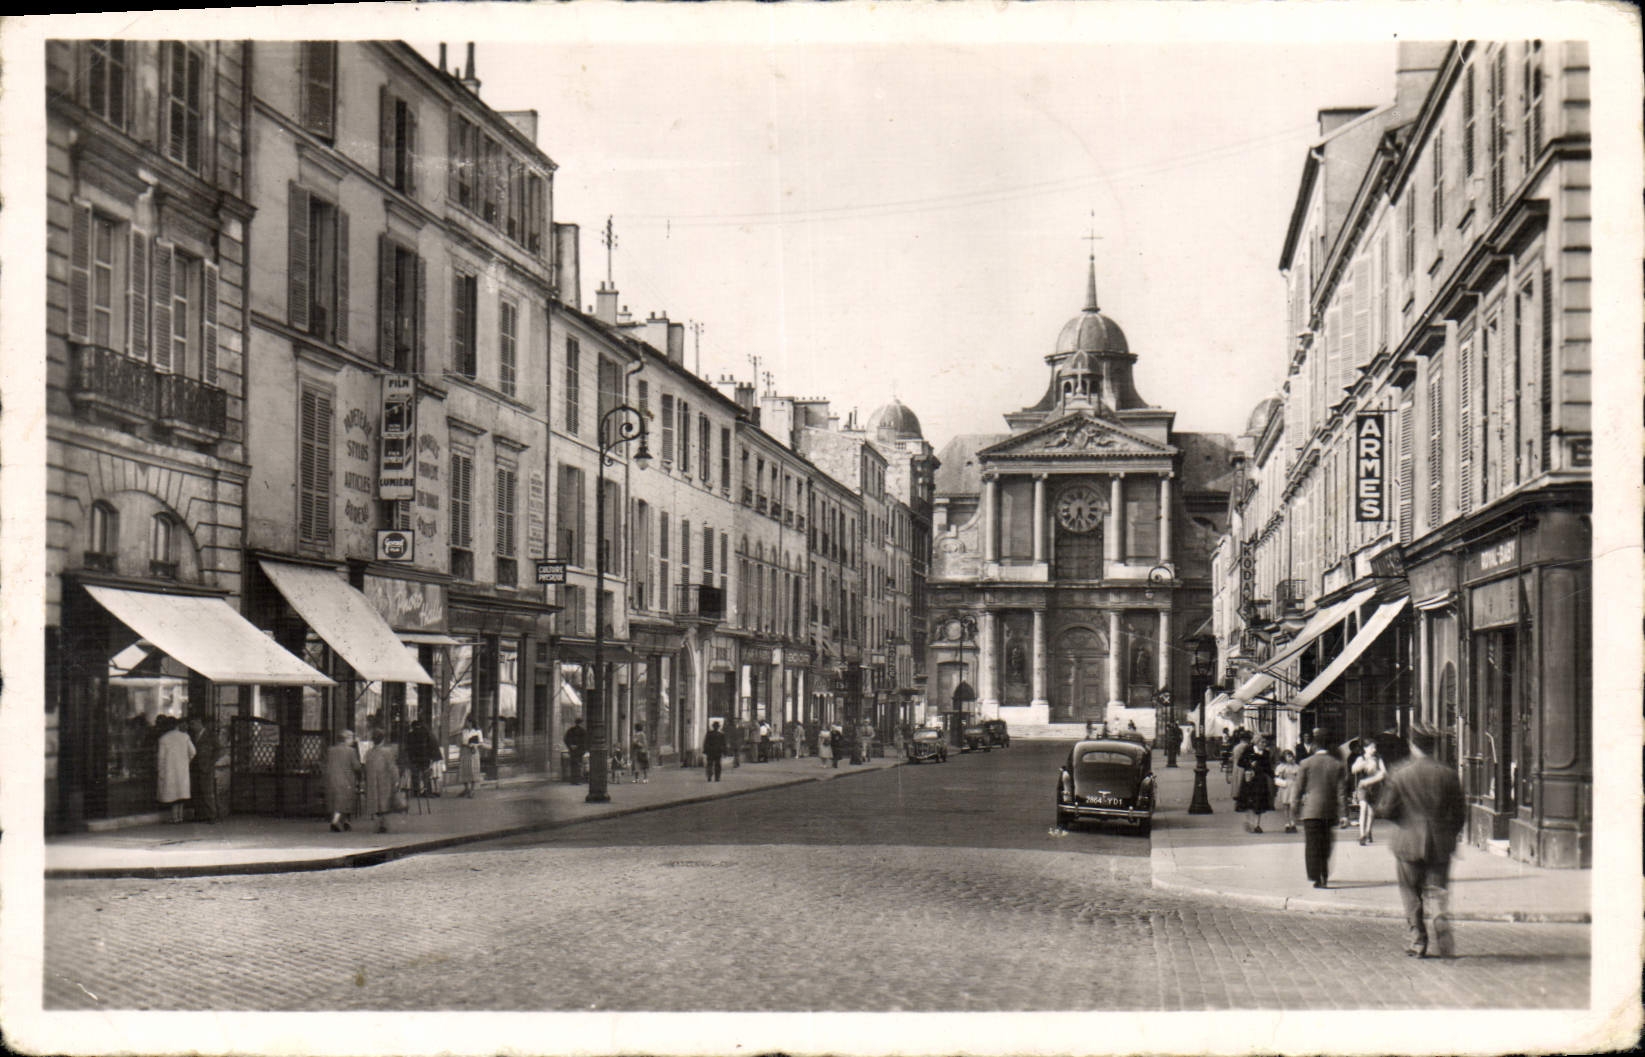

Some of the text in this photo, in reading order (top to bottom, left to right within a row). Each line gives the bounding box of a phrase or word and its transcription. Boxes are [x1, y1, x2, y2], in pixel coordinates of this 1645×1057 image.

[388, 379, 409, 388] FILM
[1359, 418, 1382, 519] ARMES
[344, 471, 371, 494] ARTICLES
